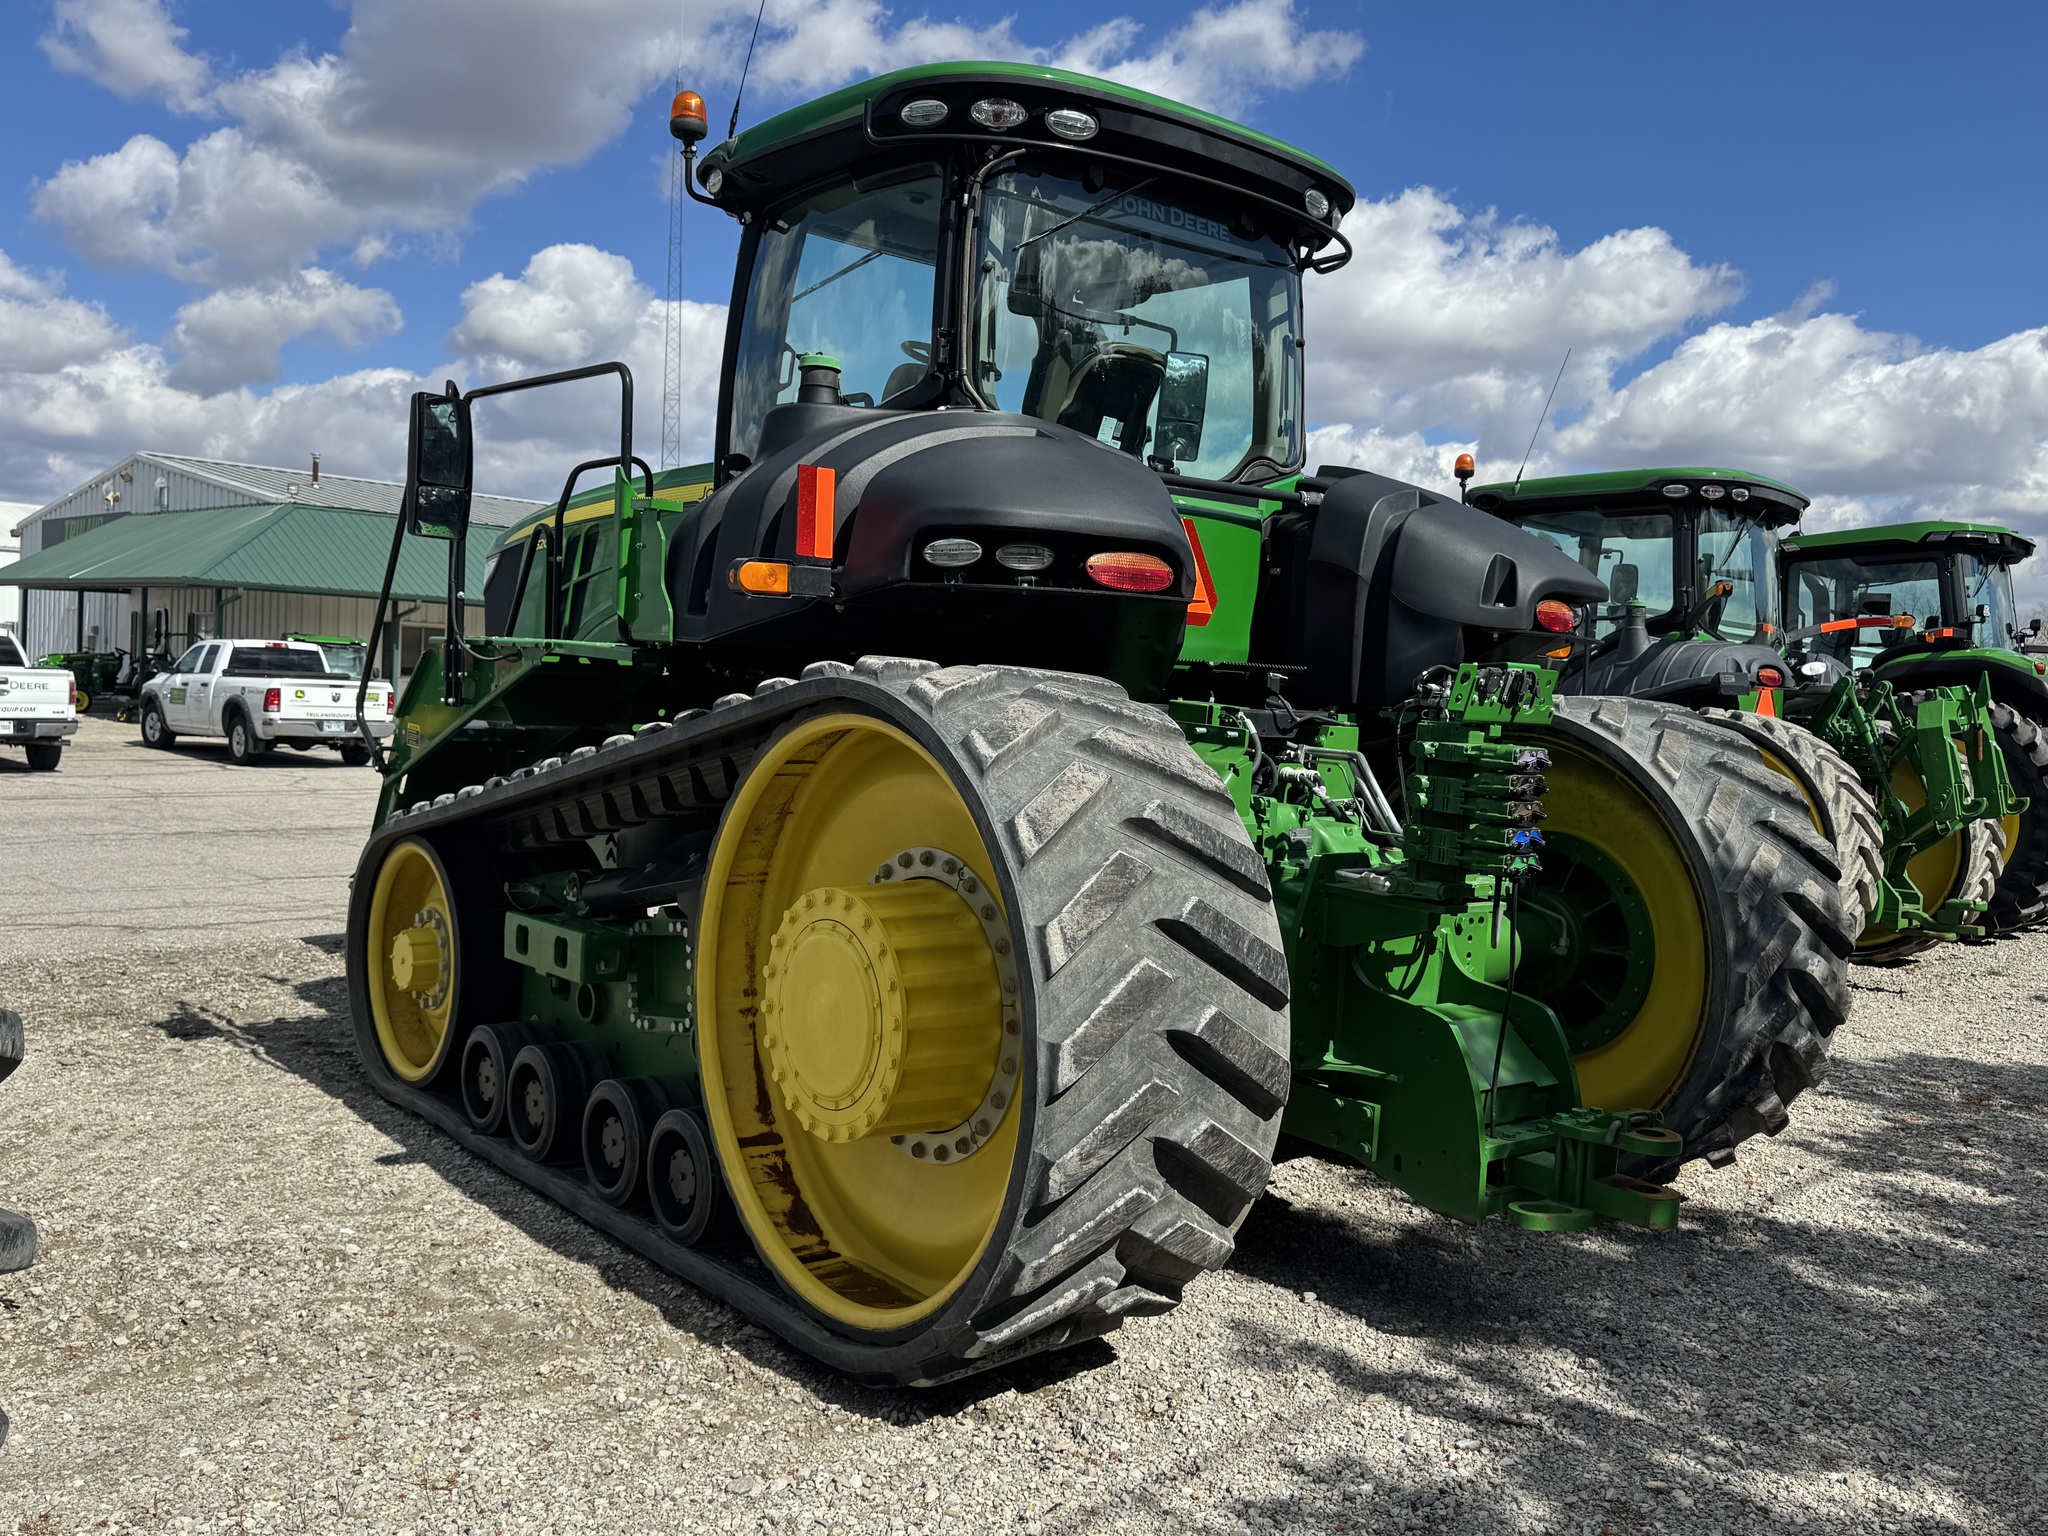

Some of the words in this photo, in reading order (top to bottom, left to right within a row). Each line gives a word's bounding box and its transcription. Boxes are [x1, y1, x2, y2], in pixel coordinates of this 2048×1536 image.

[1111, 198, 1165, 222] JOHN
[1170, 206, 1230, 241] DEERE
[10, 681, 49, 690] DEERE
